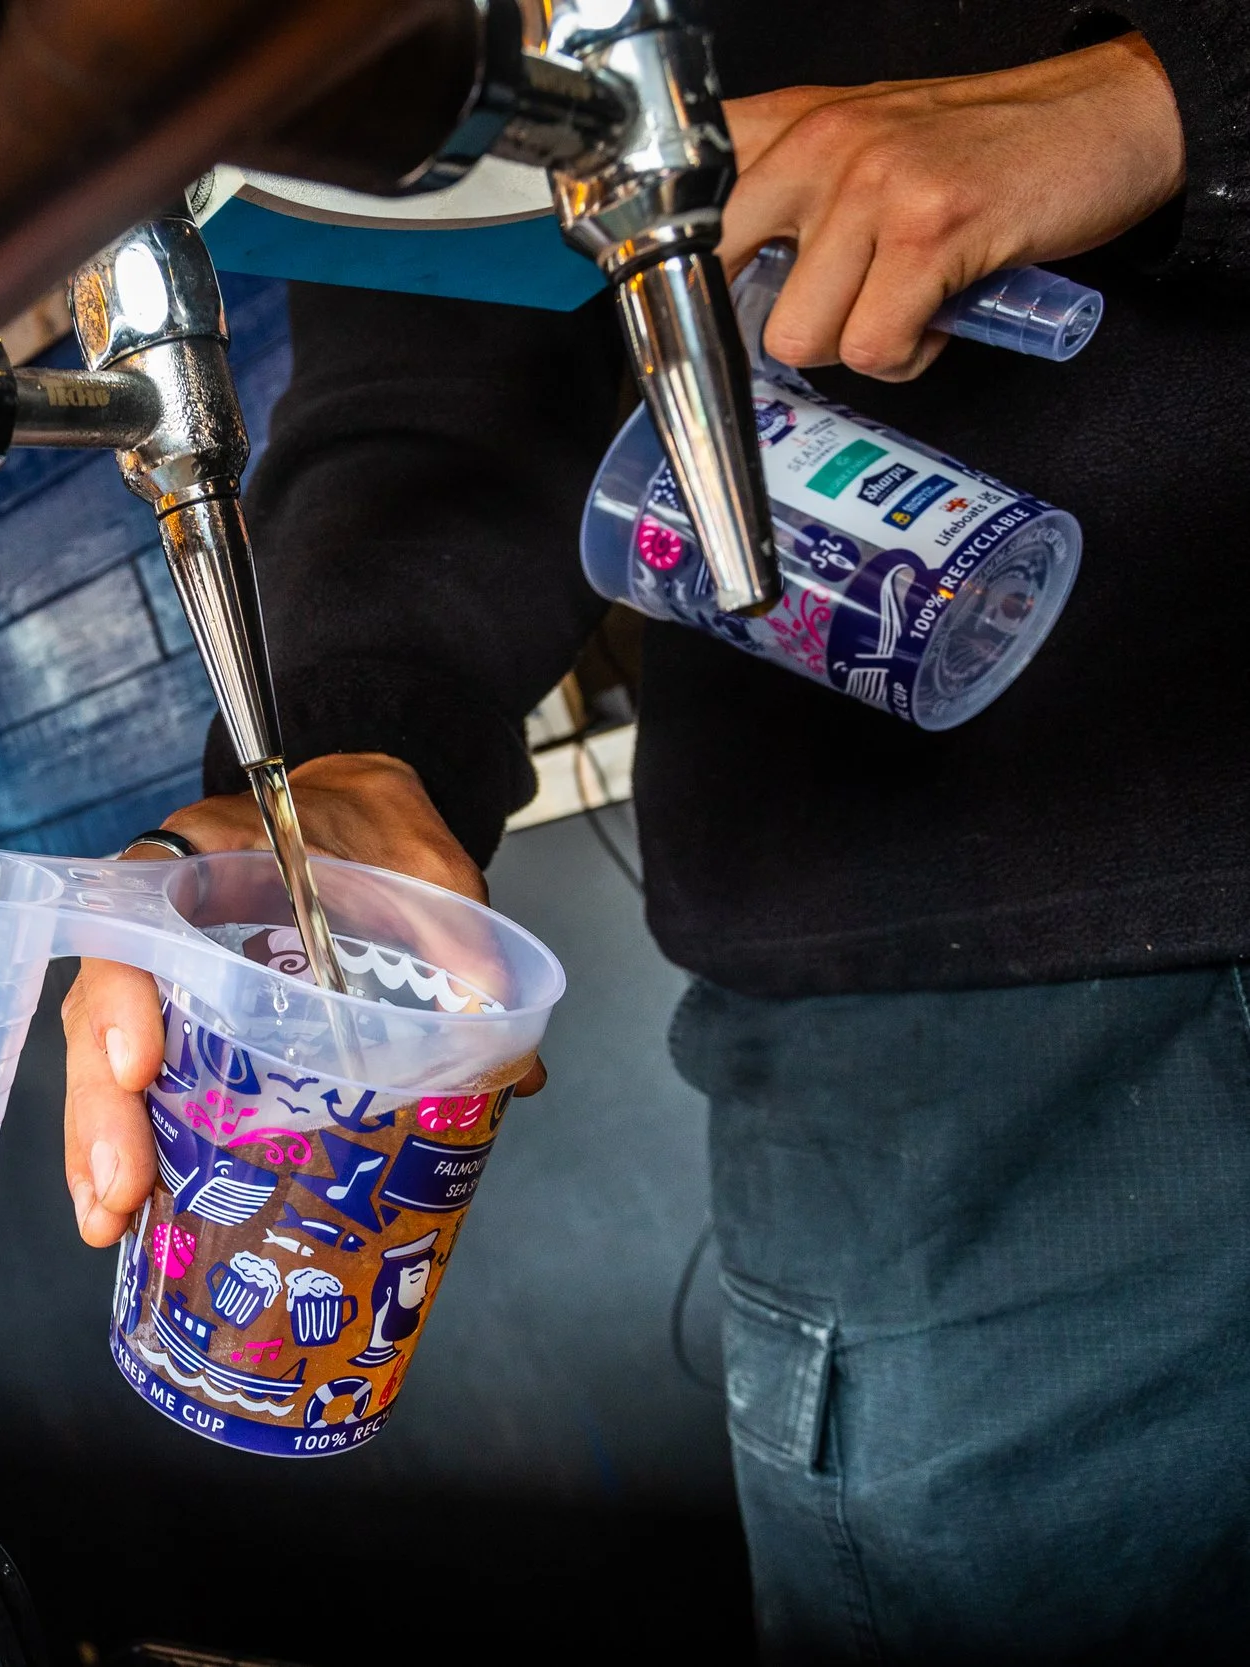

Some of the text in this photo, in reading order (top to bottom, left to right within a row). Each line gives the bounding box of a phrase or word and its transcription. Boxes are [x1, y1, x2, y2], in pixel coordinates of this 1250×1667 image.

[935, 503, 988, 547] Lifeboats
[910, 507, 1031, 640] 100% RECYCLABLE
[151, 1105, 179, 1139] HALF PINT
[445, 1182, 467, 1198] SEA
[118, 1343, 225, 1432] KEEP ME CUP
[293, 1432, 347, 1450] 100%
